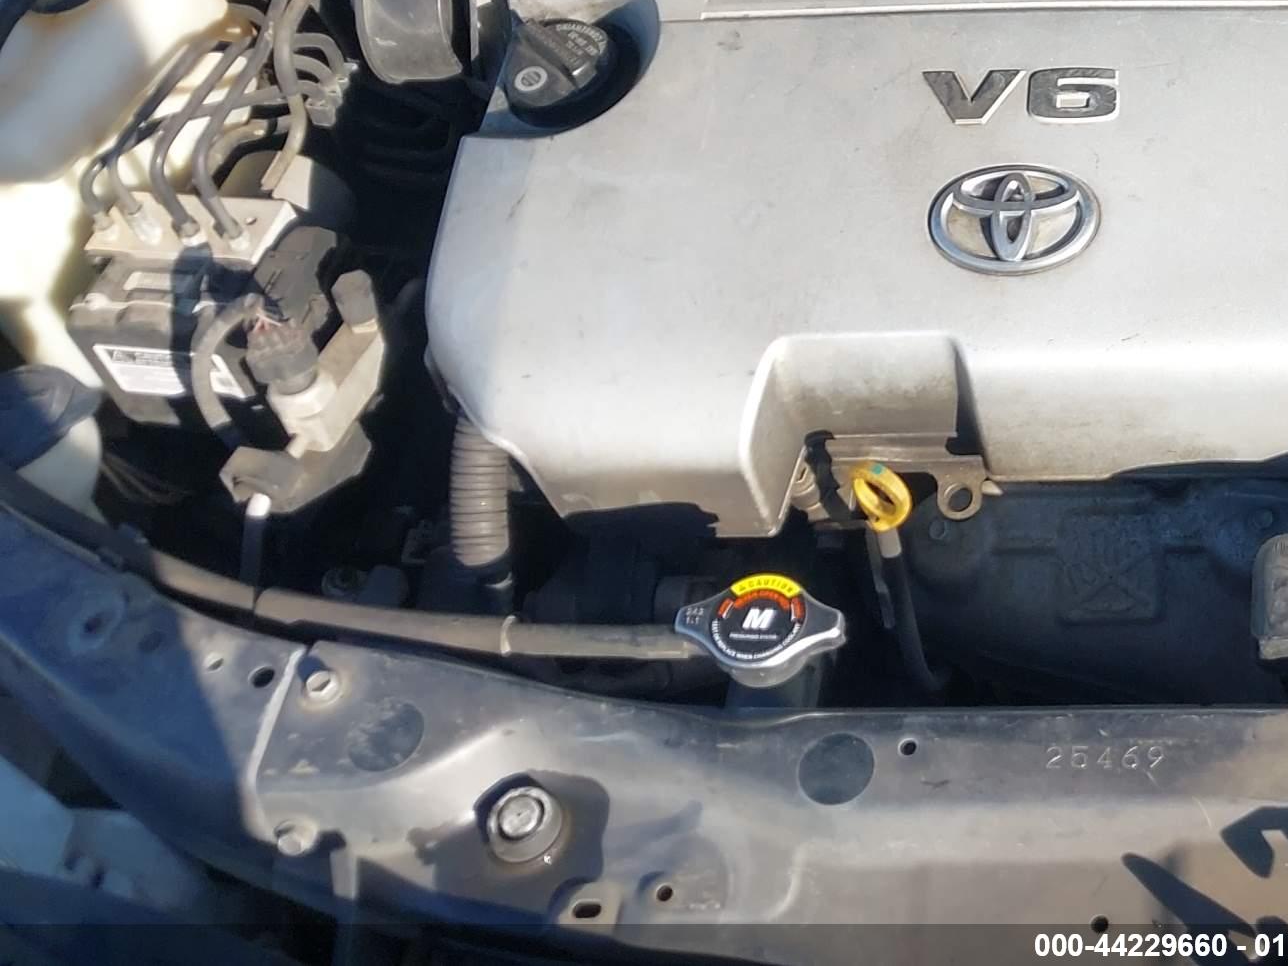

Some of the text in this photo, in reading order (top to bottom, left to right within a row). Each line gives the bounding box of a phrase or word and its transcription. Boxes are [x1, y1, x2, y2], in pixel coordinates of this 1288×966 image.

[922, 68, 1119, 124] V6
[749, 578, 794, 594] CAUTION
[742, 608, 777, 630] M
[1046, 745, 1165, 770] 25469
